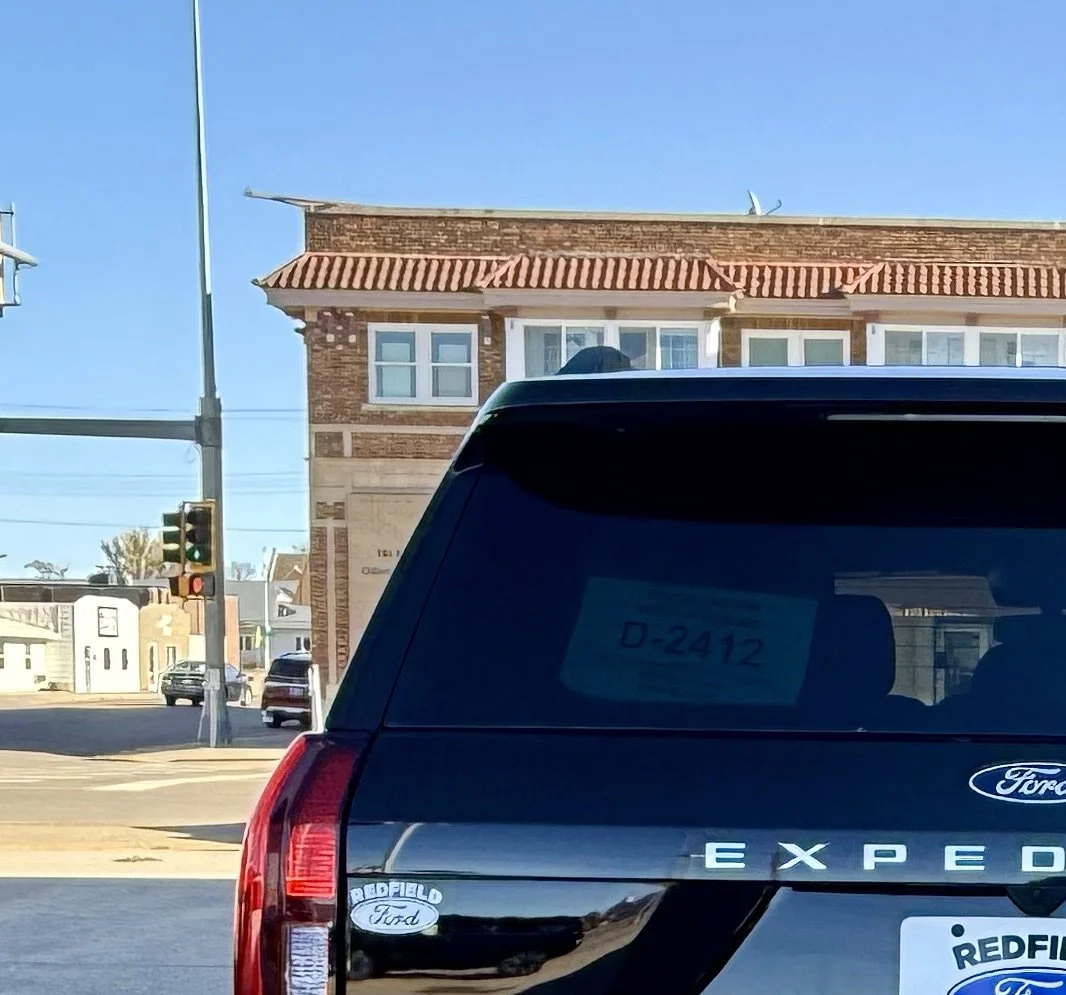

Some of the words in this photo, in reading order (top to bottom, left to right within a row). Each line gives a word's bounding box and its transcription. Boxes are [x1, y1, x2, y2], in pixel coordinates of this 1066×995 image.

[619, 620, 764, 667] D-2412
[350, 881, 443, 905] REDFIELD
[369, 903, 420, 926] Ford
